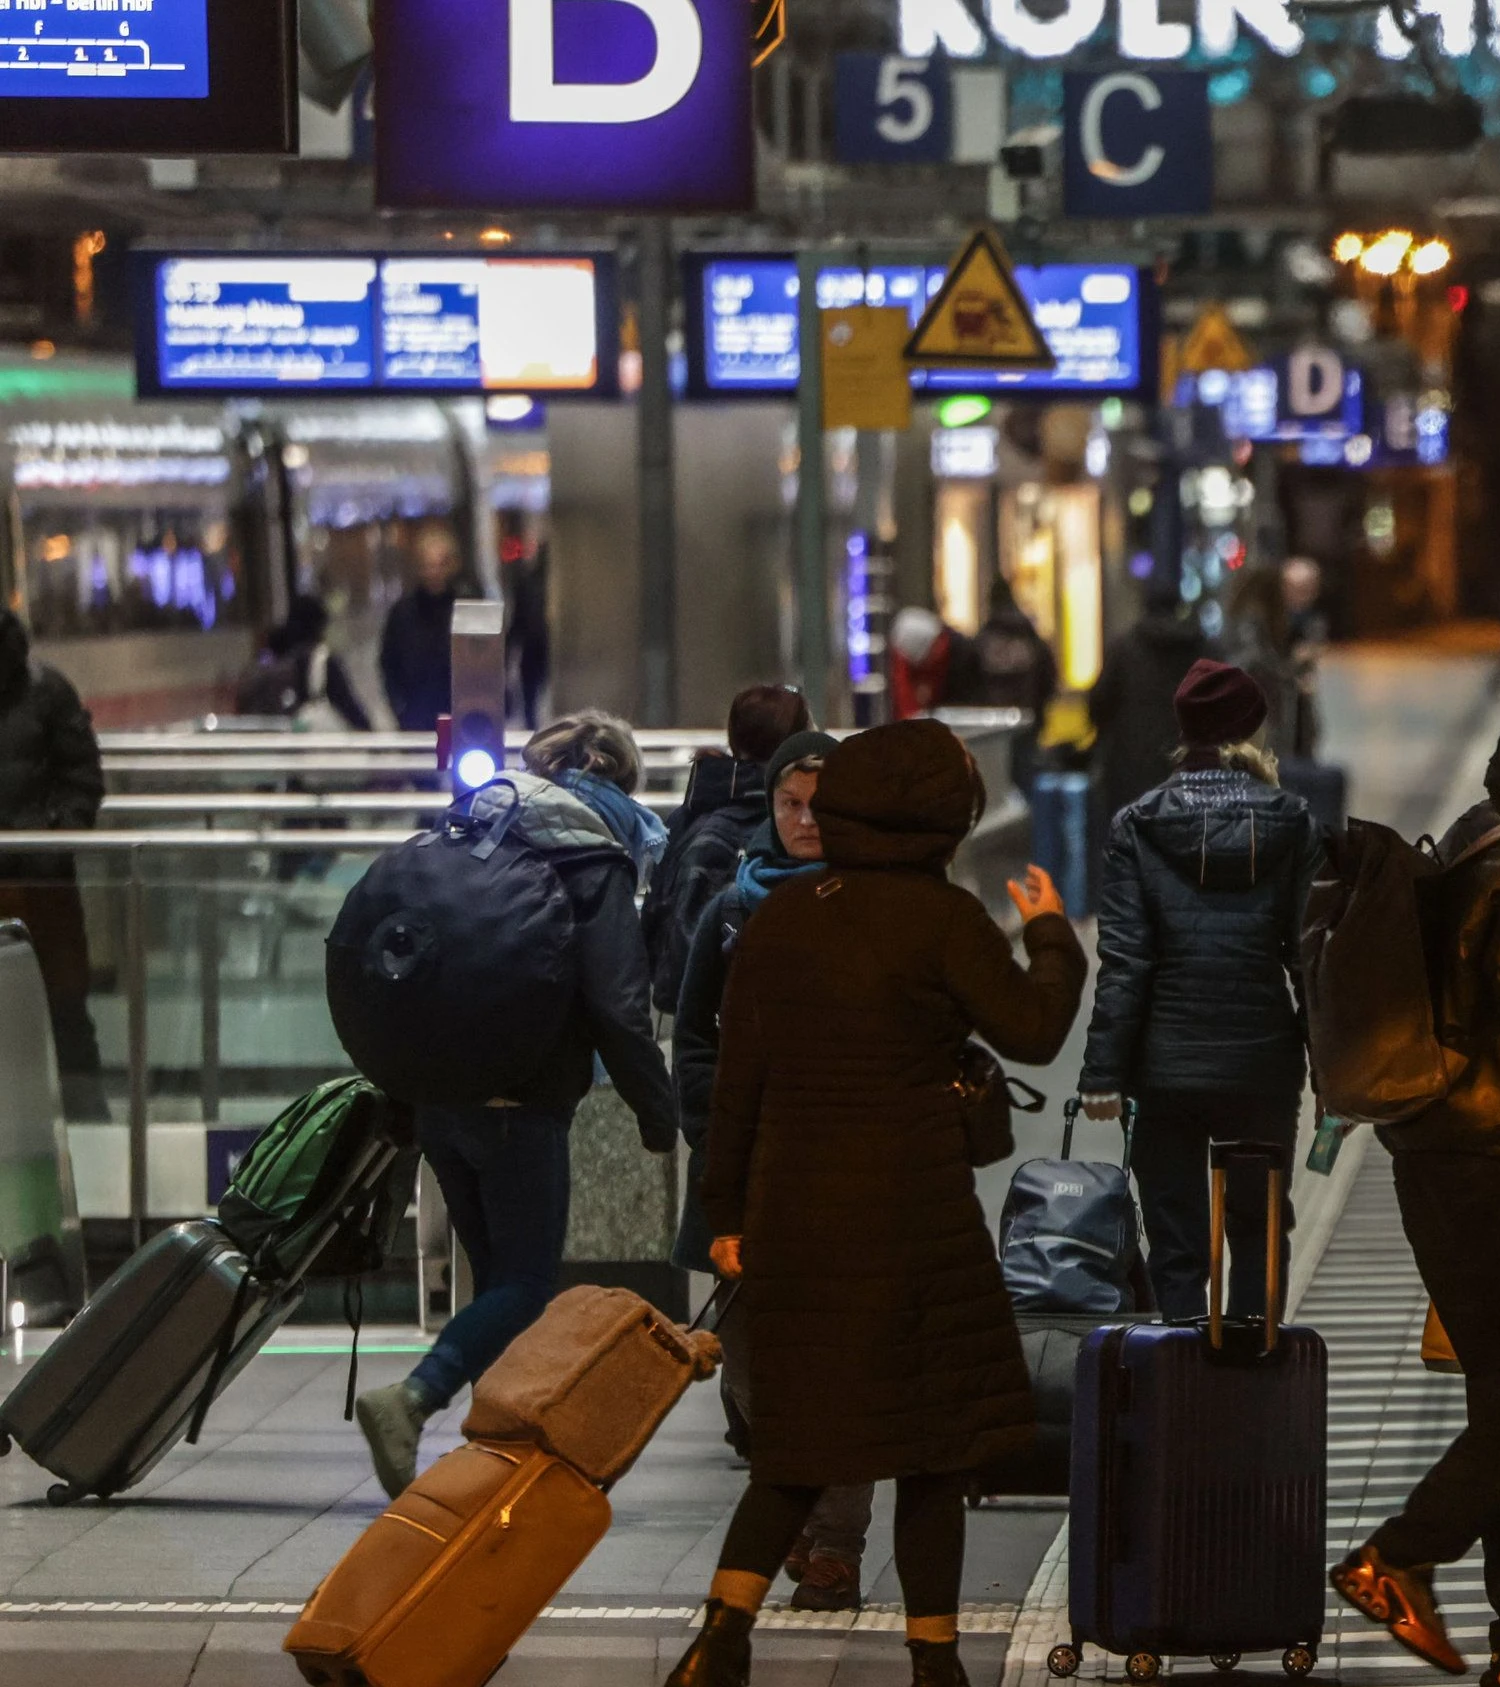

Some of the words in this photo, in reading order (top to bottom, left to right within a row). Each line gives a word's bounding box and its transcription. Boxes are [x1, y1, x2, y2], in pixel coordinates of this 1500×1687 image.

[34, 19, 44, 36] F
[118, 20, 130, 37] G
[877, 55, 933, 142] 5
[1082, 73, 1164, 187] C
[1289, 346, 1343, 414] D
